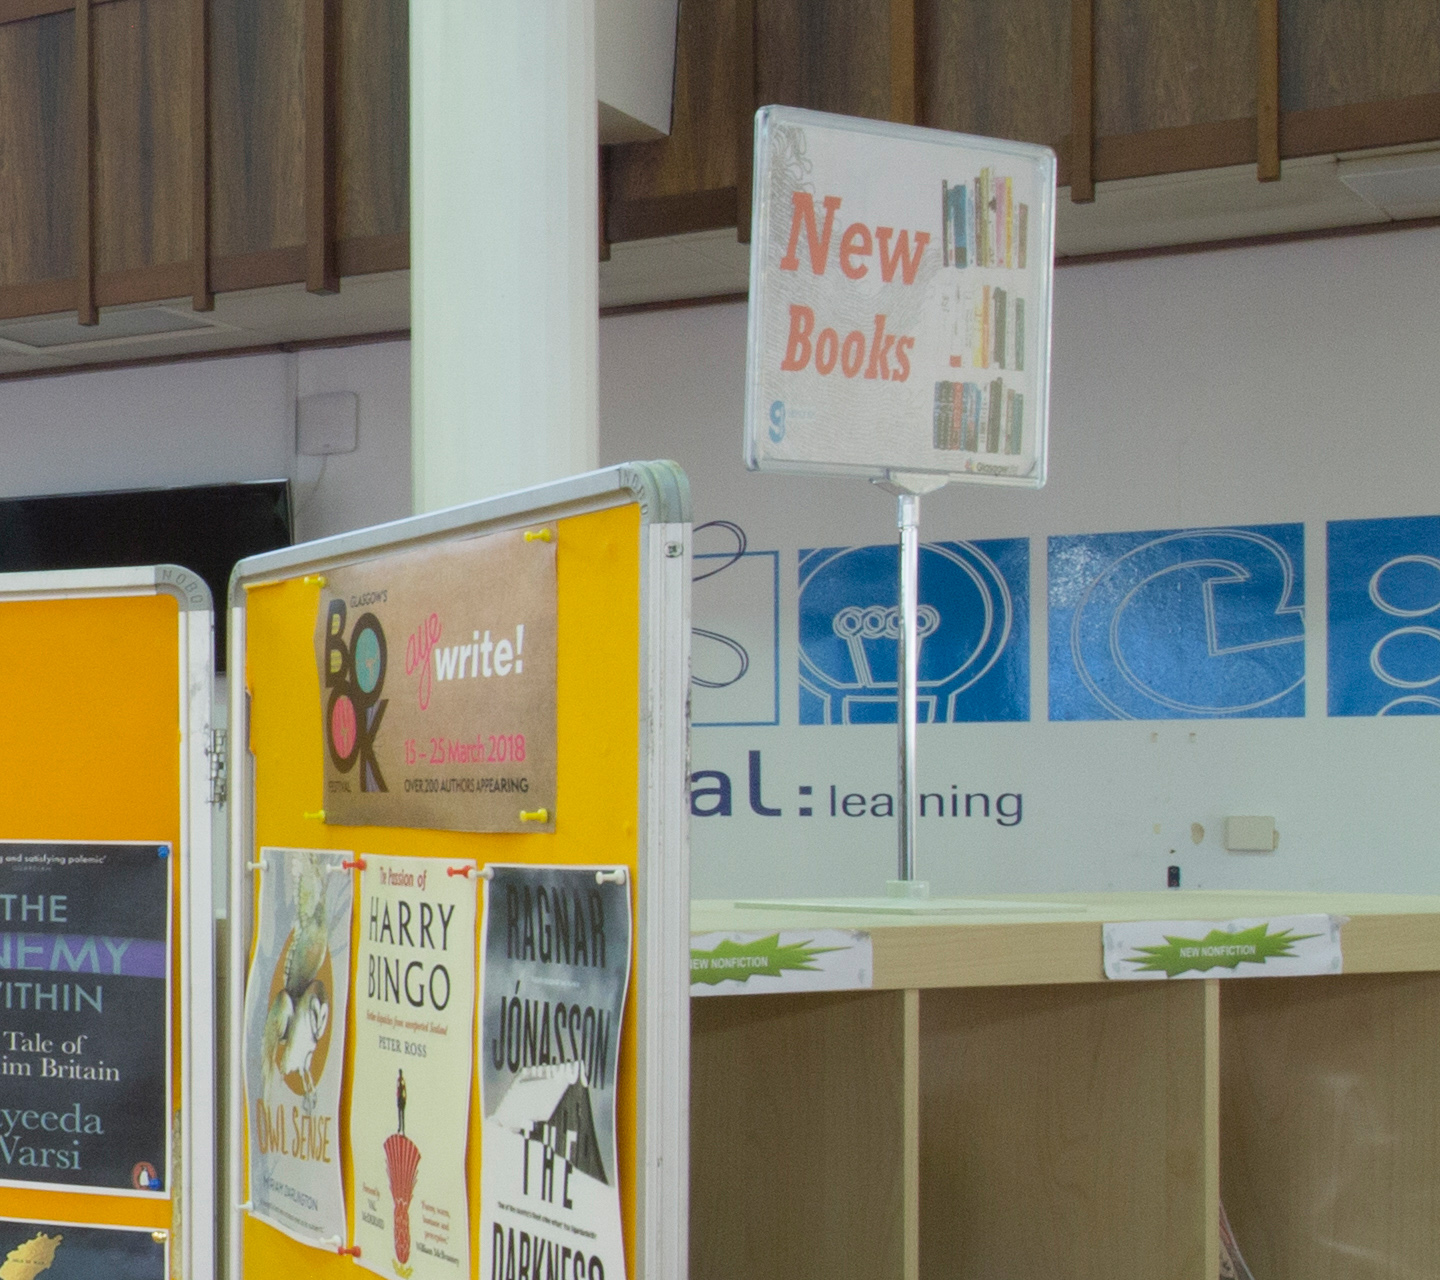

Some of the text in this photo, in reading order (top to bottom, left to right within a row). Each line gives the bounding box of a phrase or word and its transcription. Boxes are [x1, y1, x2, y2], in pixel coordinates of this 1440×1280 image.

[779, 191, 930, 285] New
[780, 305, 915, 384] Books
[405, 613, 525, 711] aye write!
[449, 734, 526, 764] March 2018
[829, 784, 1025, 827] leaning
[389, 867, 427, 891] Passion of
[0, 894, 67, 923] THE
[369, 896, 455, 951] HARRY
[507, 884, 607, 968] RAGNAR
[710, 956, 768, 970] NONFICTION
[1180, 944, 1256, 959] NEW NONFICTION
[368, 953, 451, 1011] BINGO
[3, 1031, 53, 1054] Tale
[61, 1034, 87, 1055] of
[378, 1035, 427, 1058] PETER ROSS
[492, 980, 612, 1091] JÓNASSON
[41, 1058, 120, 1082] Britain
[256, 1098, 331, 1163] OWL SENSE
[517, 1121, 578, 1210] THE
